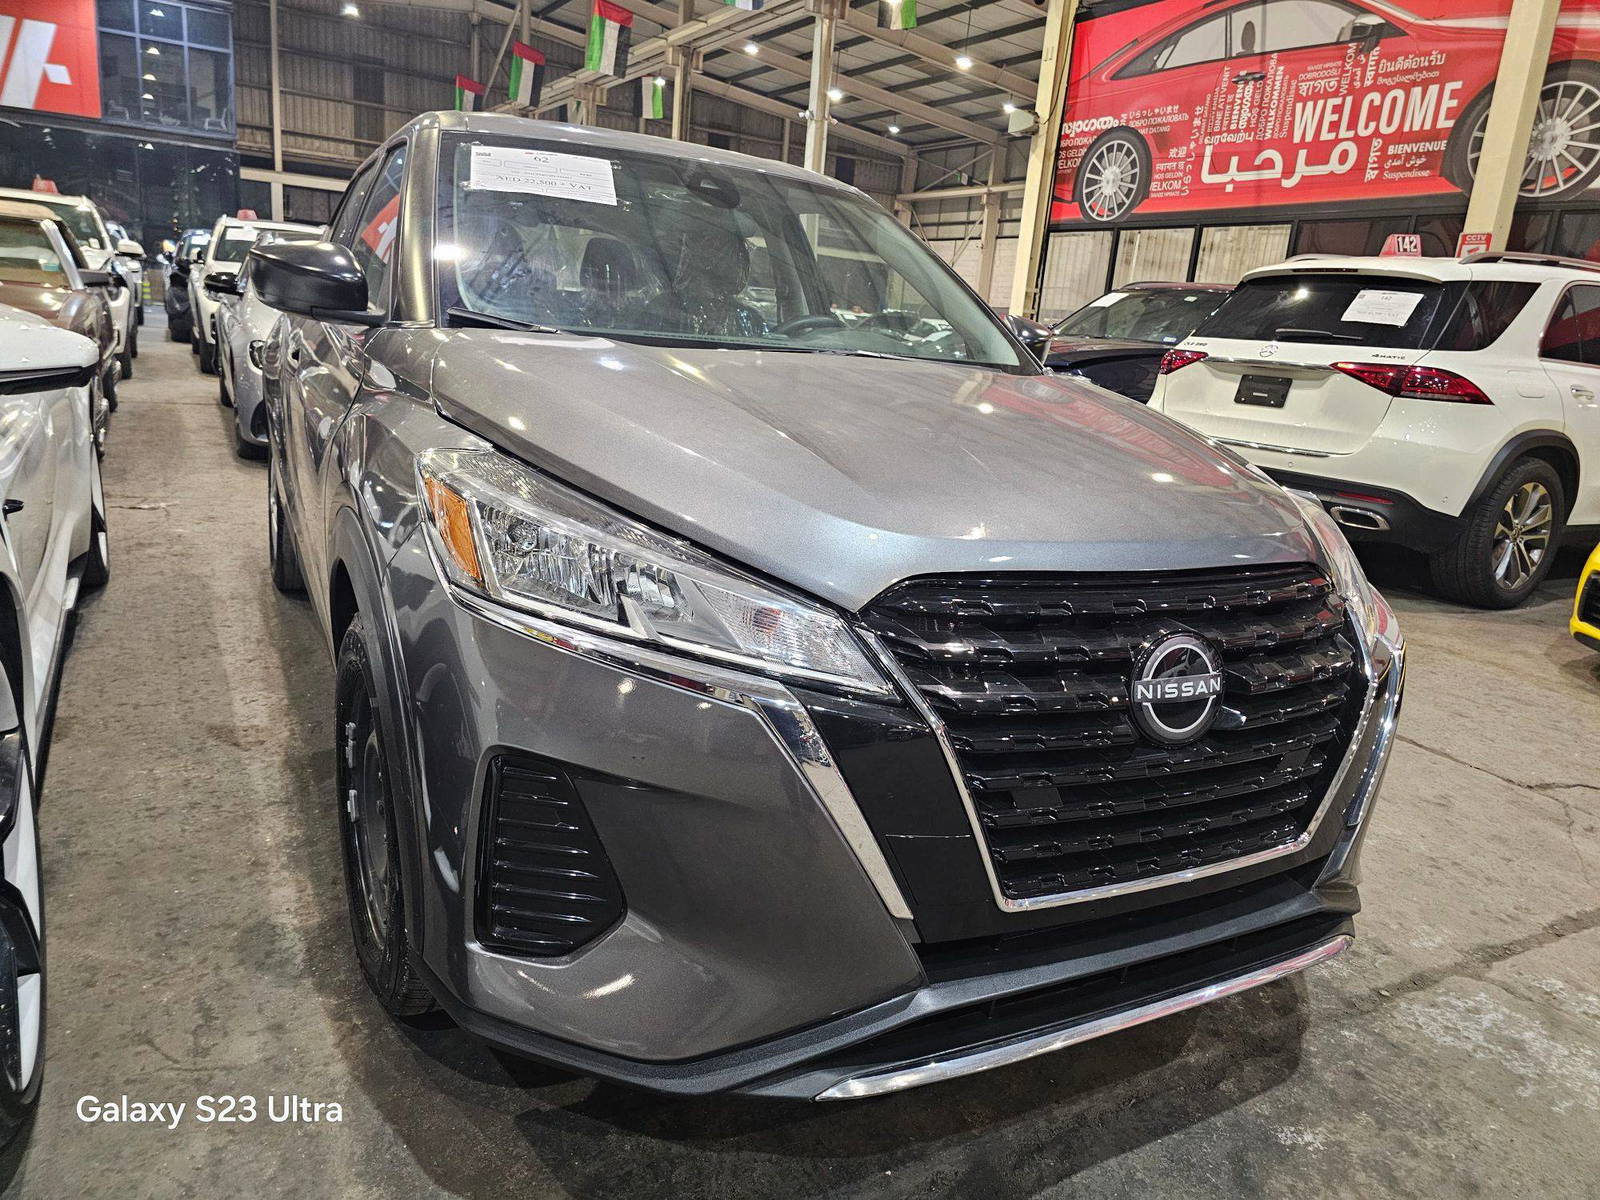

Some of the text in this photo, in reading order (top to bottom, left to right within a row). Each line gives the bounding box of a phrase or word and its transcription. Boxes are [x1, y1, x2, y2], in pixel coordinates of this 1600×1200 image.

[1339, 42, 1357, 96] WELKOM
[1264, 66, 1285, 140] WILLKOMMEN
[1293, 81, 1463, 144] WELCOME
[1213, 112, 1223, 132] BINE
[1387, 140, 1448, 155] BIENVENUE
[1201, 141, 1357, 192] مرحبا
[495, 175, 521, 183] AED
[569, 183, 593, 191] VAT
[1150, 180, 1182, 191] ELKOM
[1397, 236, 1417, 252] 142
[1137, 677, 1220, 699] NISSAN
